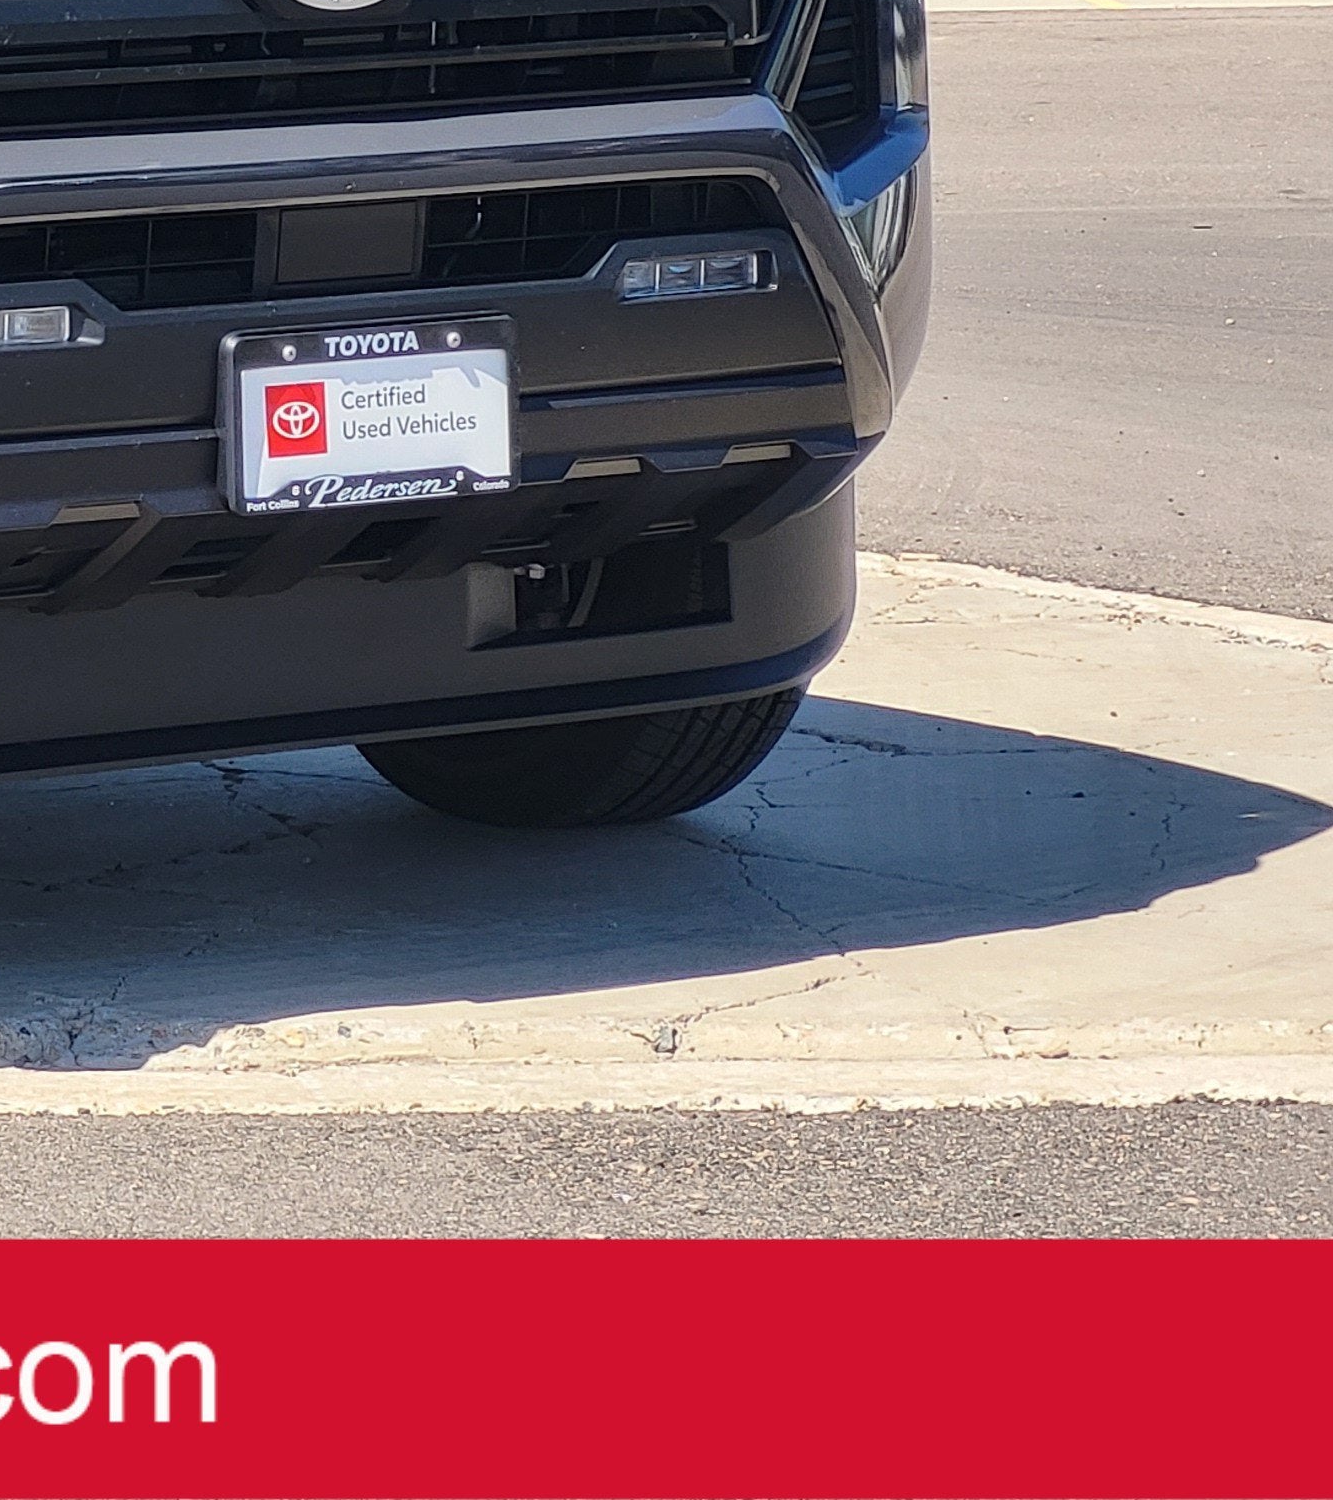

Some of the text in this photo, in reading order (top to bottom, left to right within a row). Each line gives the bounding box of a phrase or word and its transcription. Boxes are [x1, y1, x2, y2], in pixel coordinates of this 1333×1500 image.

[324, 330, 420, 358] TOYOTA
[340, 384, 426, 410] Certified
[342, 411, 477, 440] Used Vehicles
[304, 474, 457, 509] Pedersen
